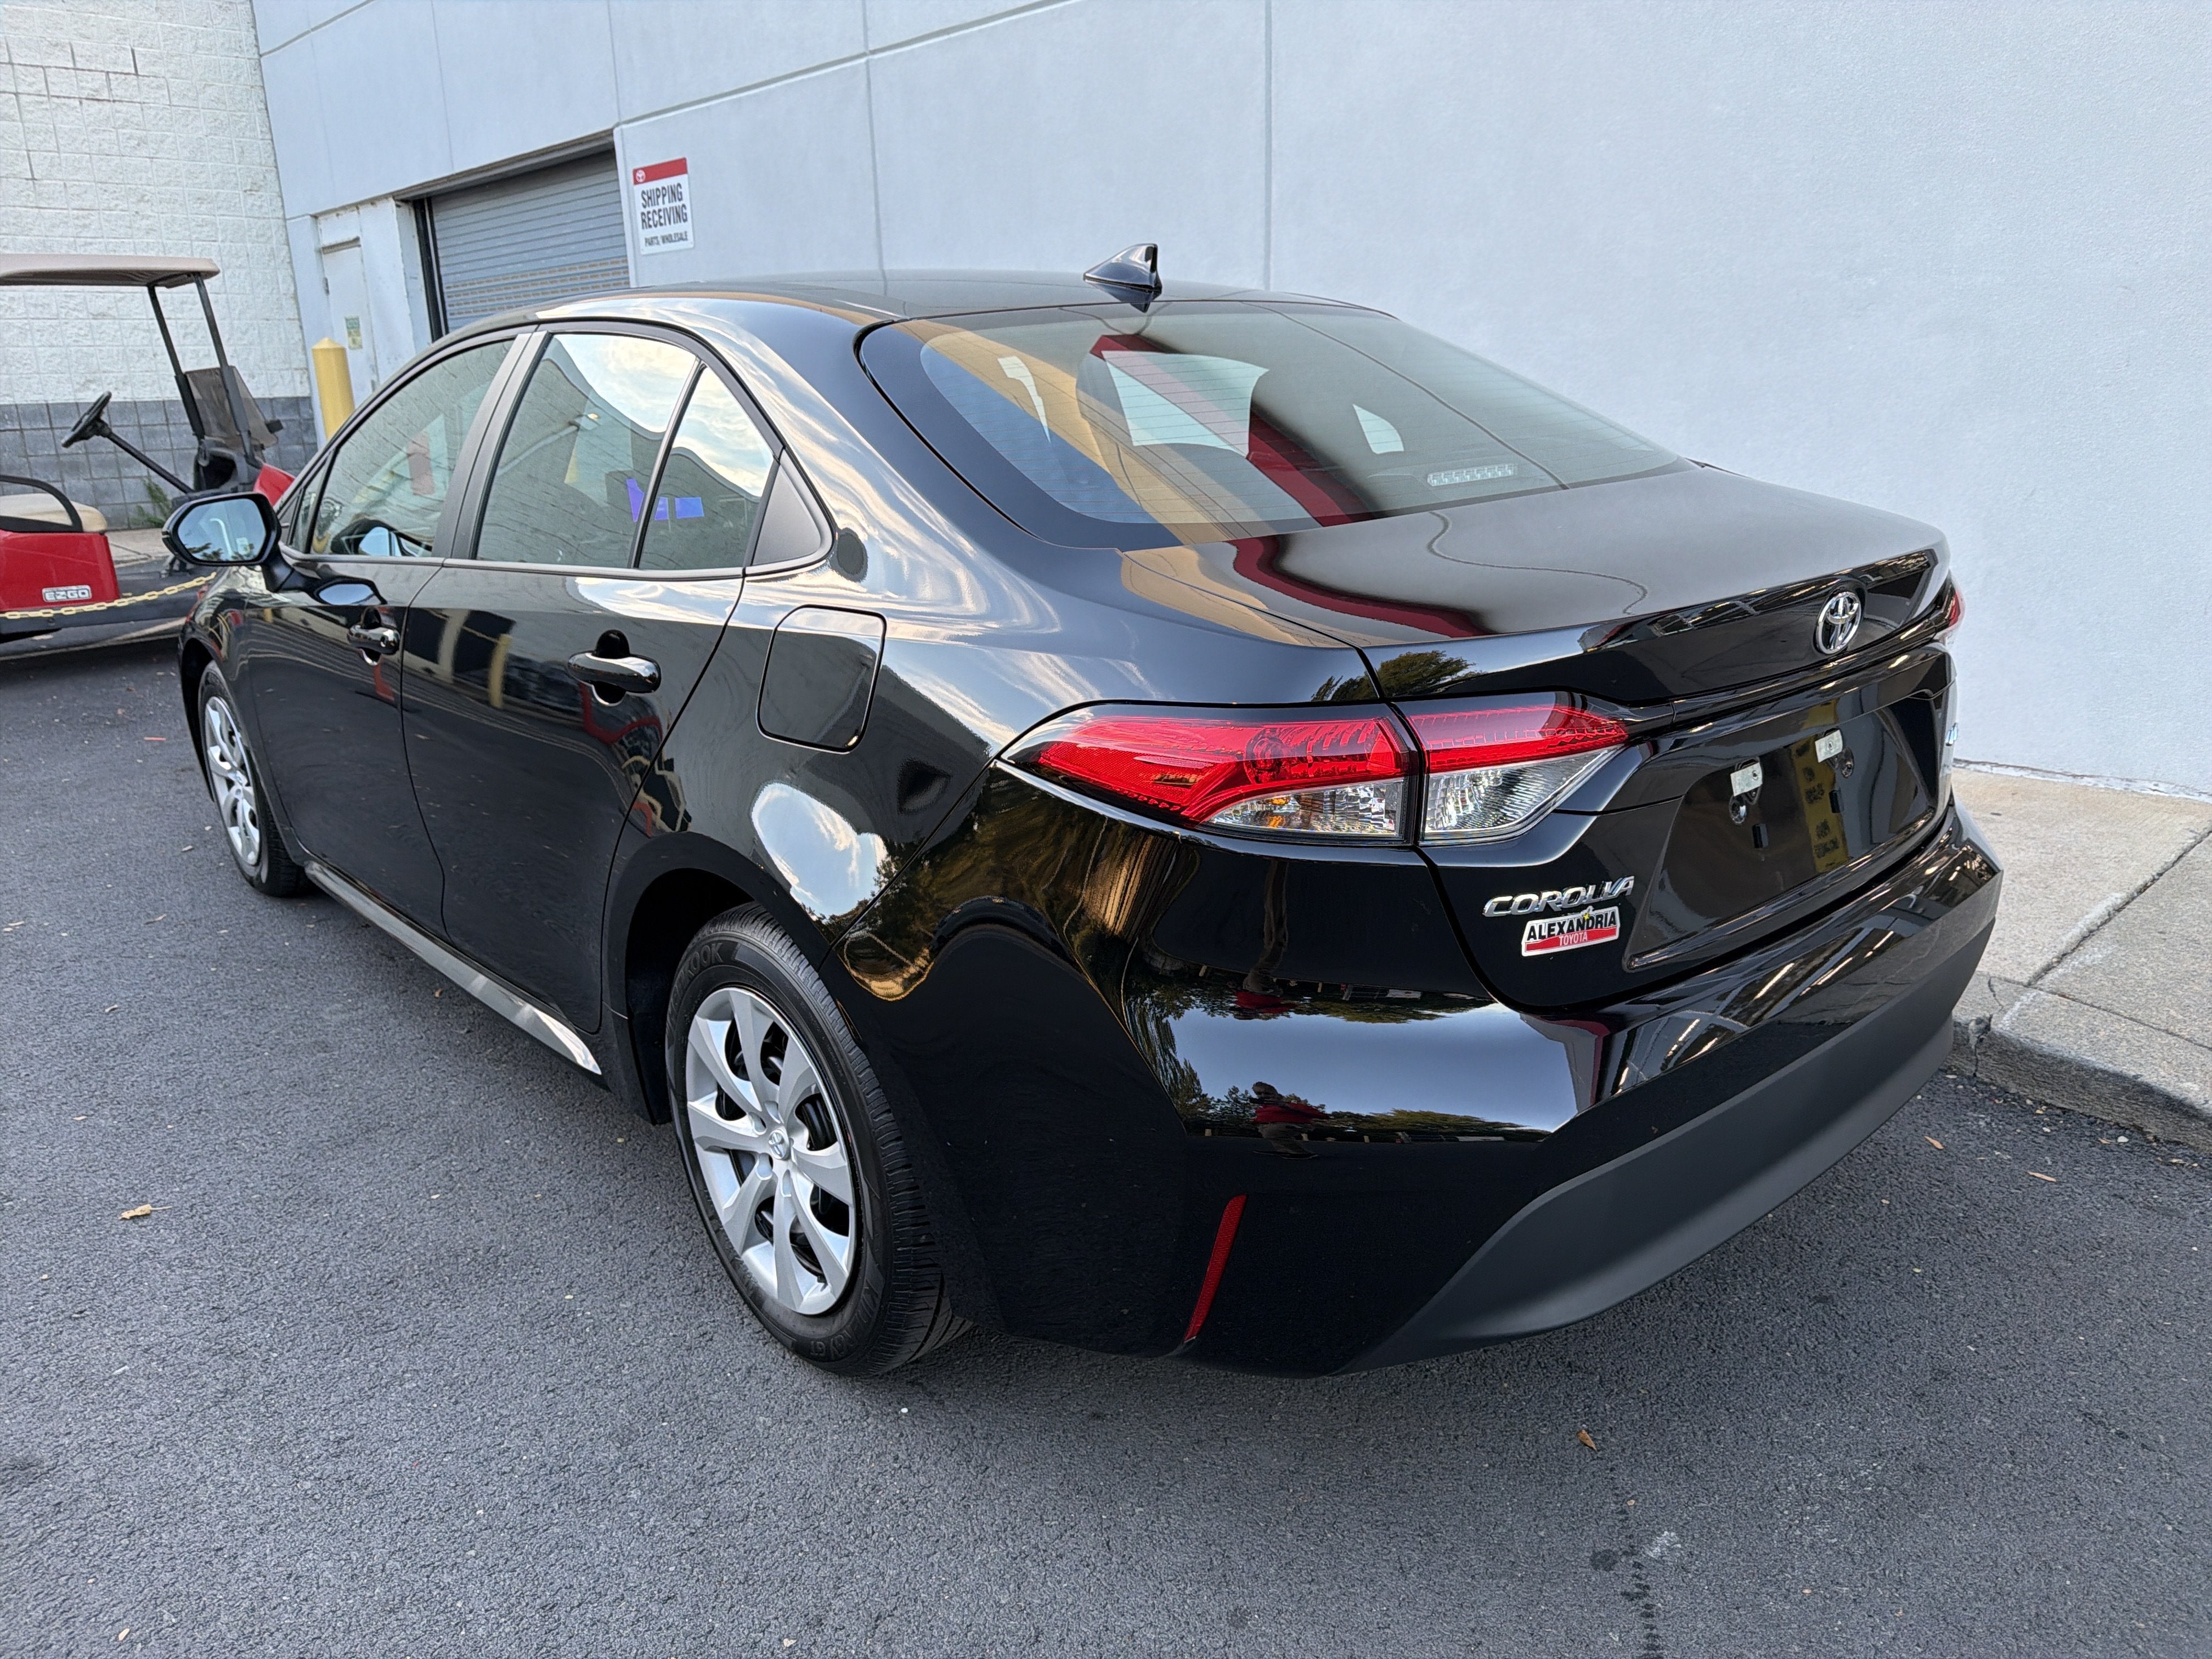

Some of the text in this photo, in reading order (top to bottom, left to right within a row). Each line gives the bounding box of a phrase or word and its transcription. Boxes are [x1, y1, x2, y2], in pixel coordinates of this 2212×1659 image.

[641, 183, 683, 208] SHIPPING
[641, 204, 688, 229] RECEIVING
[645, 231, 688, 246] PARTS WHOLESALE
[1482, 876, 1634, 917] COROLLA
[1527, 911, 1617, 941] ALEXANDRIA
[1559, 932, 1588, 946] TOYOTA
